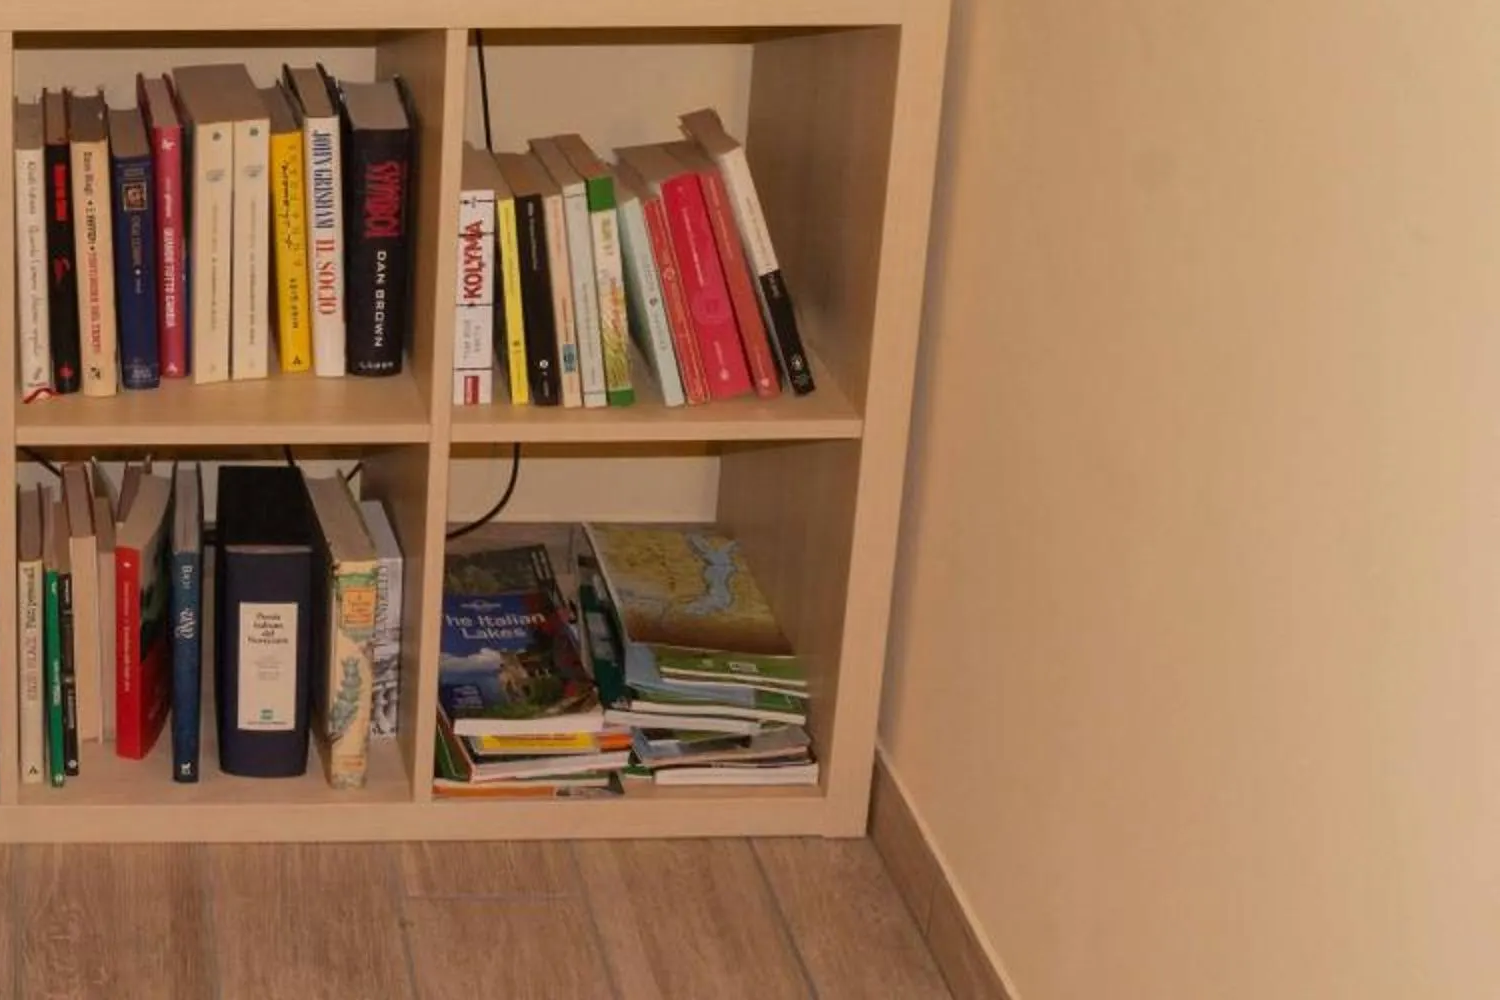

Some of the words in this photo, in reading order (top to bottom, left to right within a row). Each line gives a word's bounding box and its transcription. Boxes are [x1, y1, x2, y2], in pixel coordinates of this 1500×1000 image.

[314, 168, 336, 229] GRISHAM
[316, 261, 338, 315] SOCIO
[376, 251, 387, 284] DAN
[374, 289, 385, 347] BROWN
[461, 626, 527, 640] Lakes
[478, 612, 546, 628] Italian
